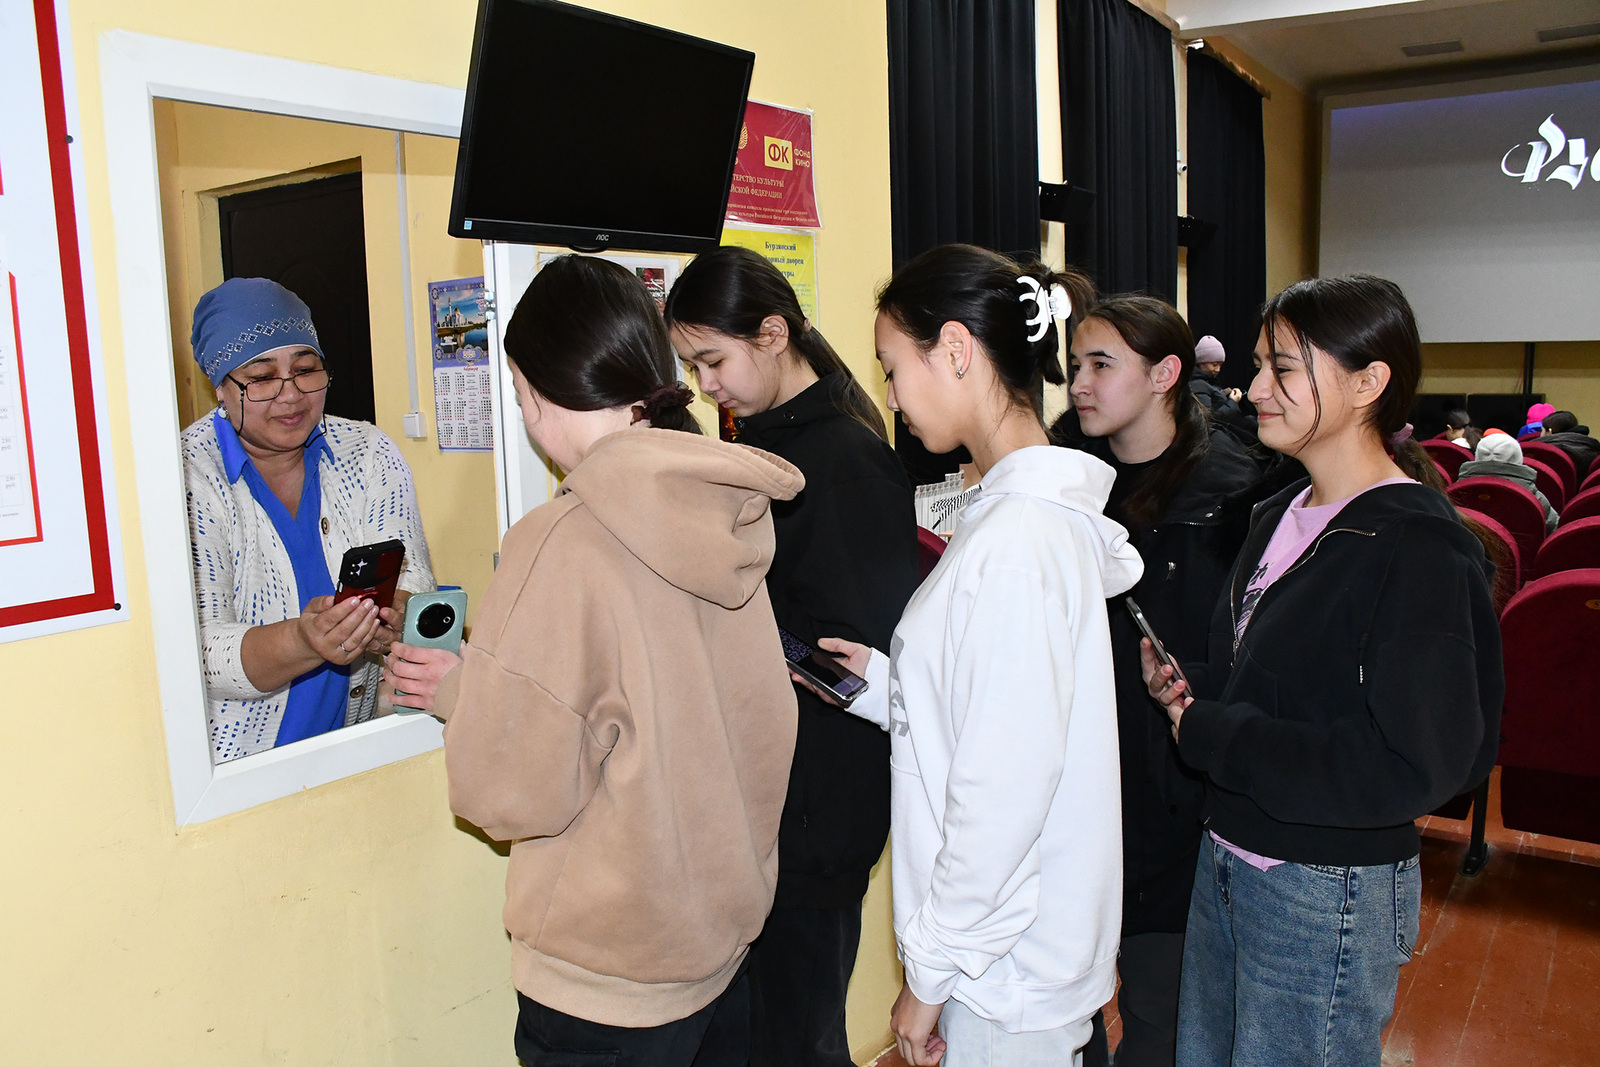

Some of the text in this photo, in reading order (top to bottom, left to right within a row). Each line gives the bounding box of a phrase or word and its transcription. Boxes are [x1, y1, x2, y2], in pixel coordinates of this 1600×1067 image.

[768, 143, 789, 163] ФК
[733, 173, 784, 188] ТЕРСТВО КУЛЬТУРЫ
[730, 184, 782, 199] ЙСКОЙ ФЕДЕРАЦИИ
